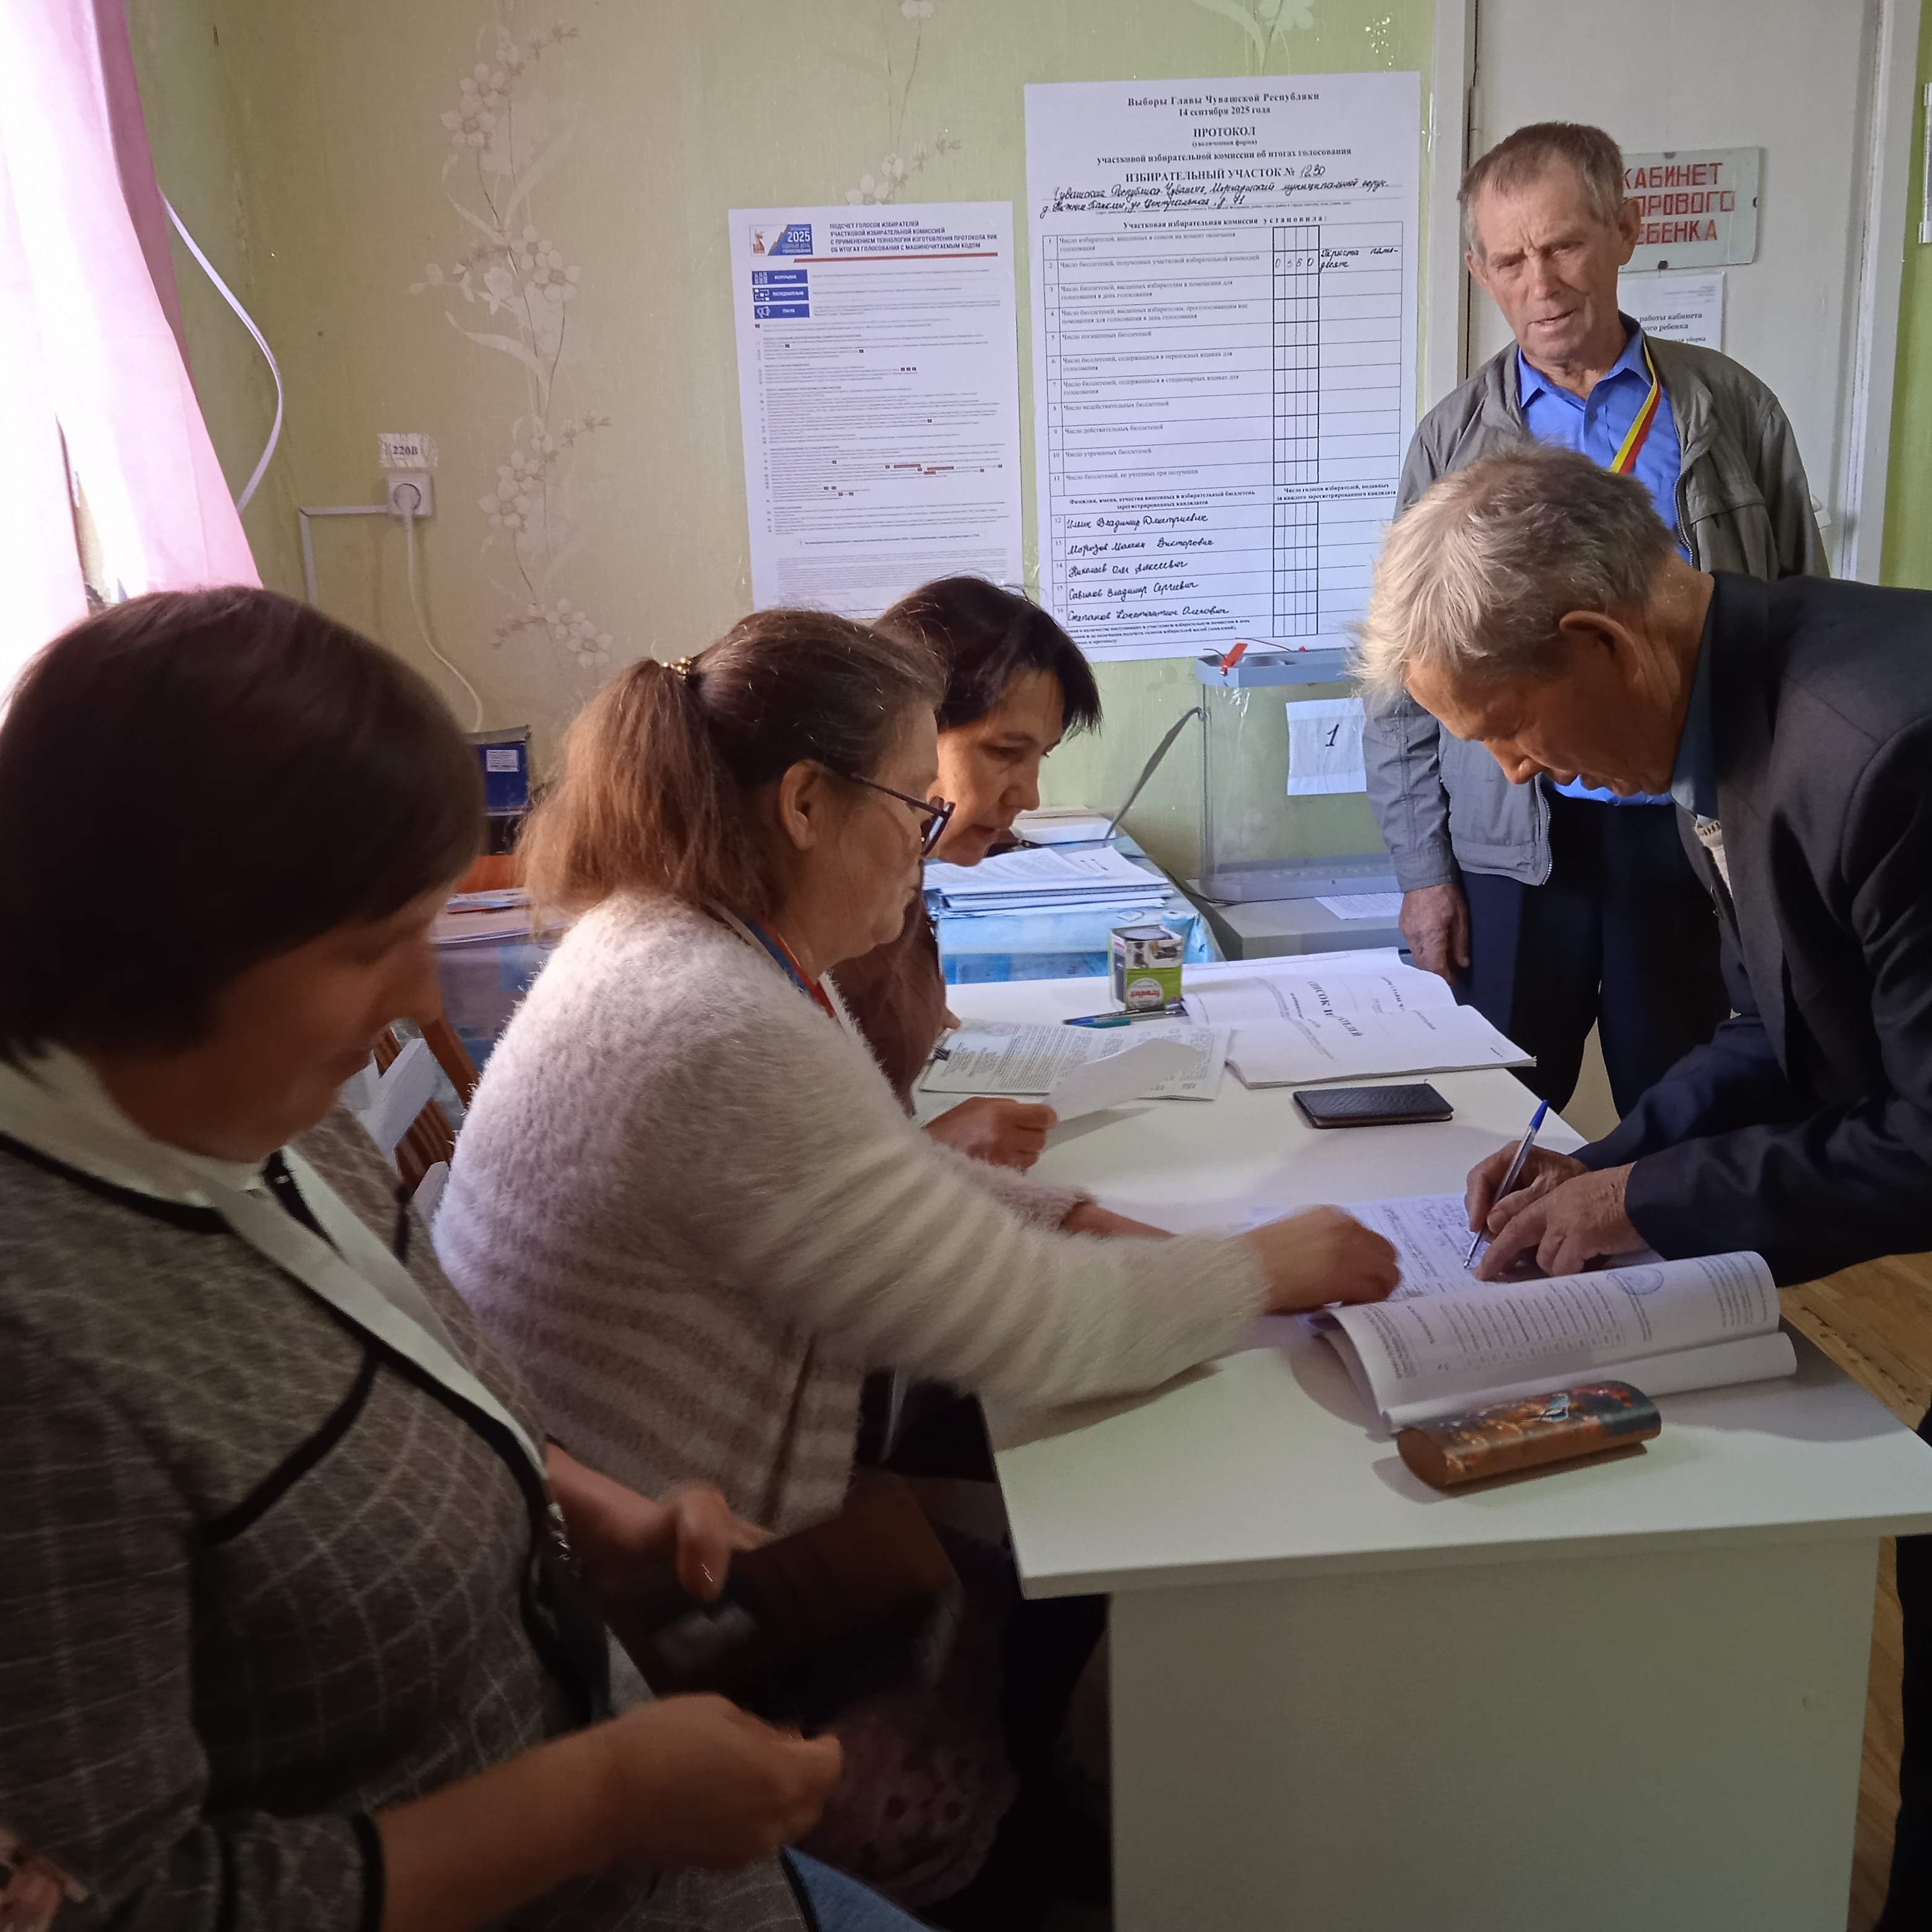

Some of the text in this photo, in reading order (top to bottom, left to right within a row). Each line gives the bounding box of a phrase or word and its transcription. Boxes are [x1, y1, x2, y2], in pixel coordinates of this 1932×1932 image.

[1128, 98, 1167, 107] Выборы
[1206, 95, 1260, 106] Чувашской
[1263, 93, 1319, 102] Республики
[1179, 108, 1187, 116] 14
[1190, 107, 1229, 116] сентября
[1231, 105, 1250, 115] 2025
[1194, 127, 1256, 137] ПРОТОКОЛ
[1097, 155, 1146, 163] участковой
[1256, 150, 1266, 158] об
[1126, 167, 1294, 182] ИЗБИРАТЕЛЬНЫЙ УЧАСТОК №
[1622, 162, 1723, 190] КАБИНЕТ
[787, 232, 811, 242] 2025
[1635, 219, 1718, 245] ЕБЕНКА
[1640, 312, 1702, 323] работы кабинета
[1659, 323, 1689, 332] ребенка
[393, 446, 419, 455] 220В
[1325, 724, 1339, 747] 1
